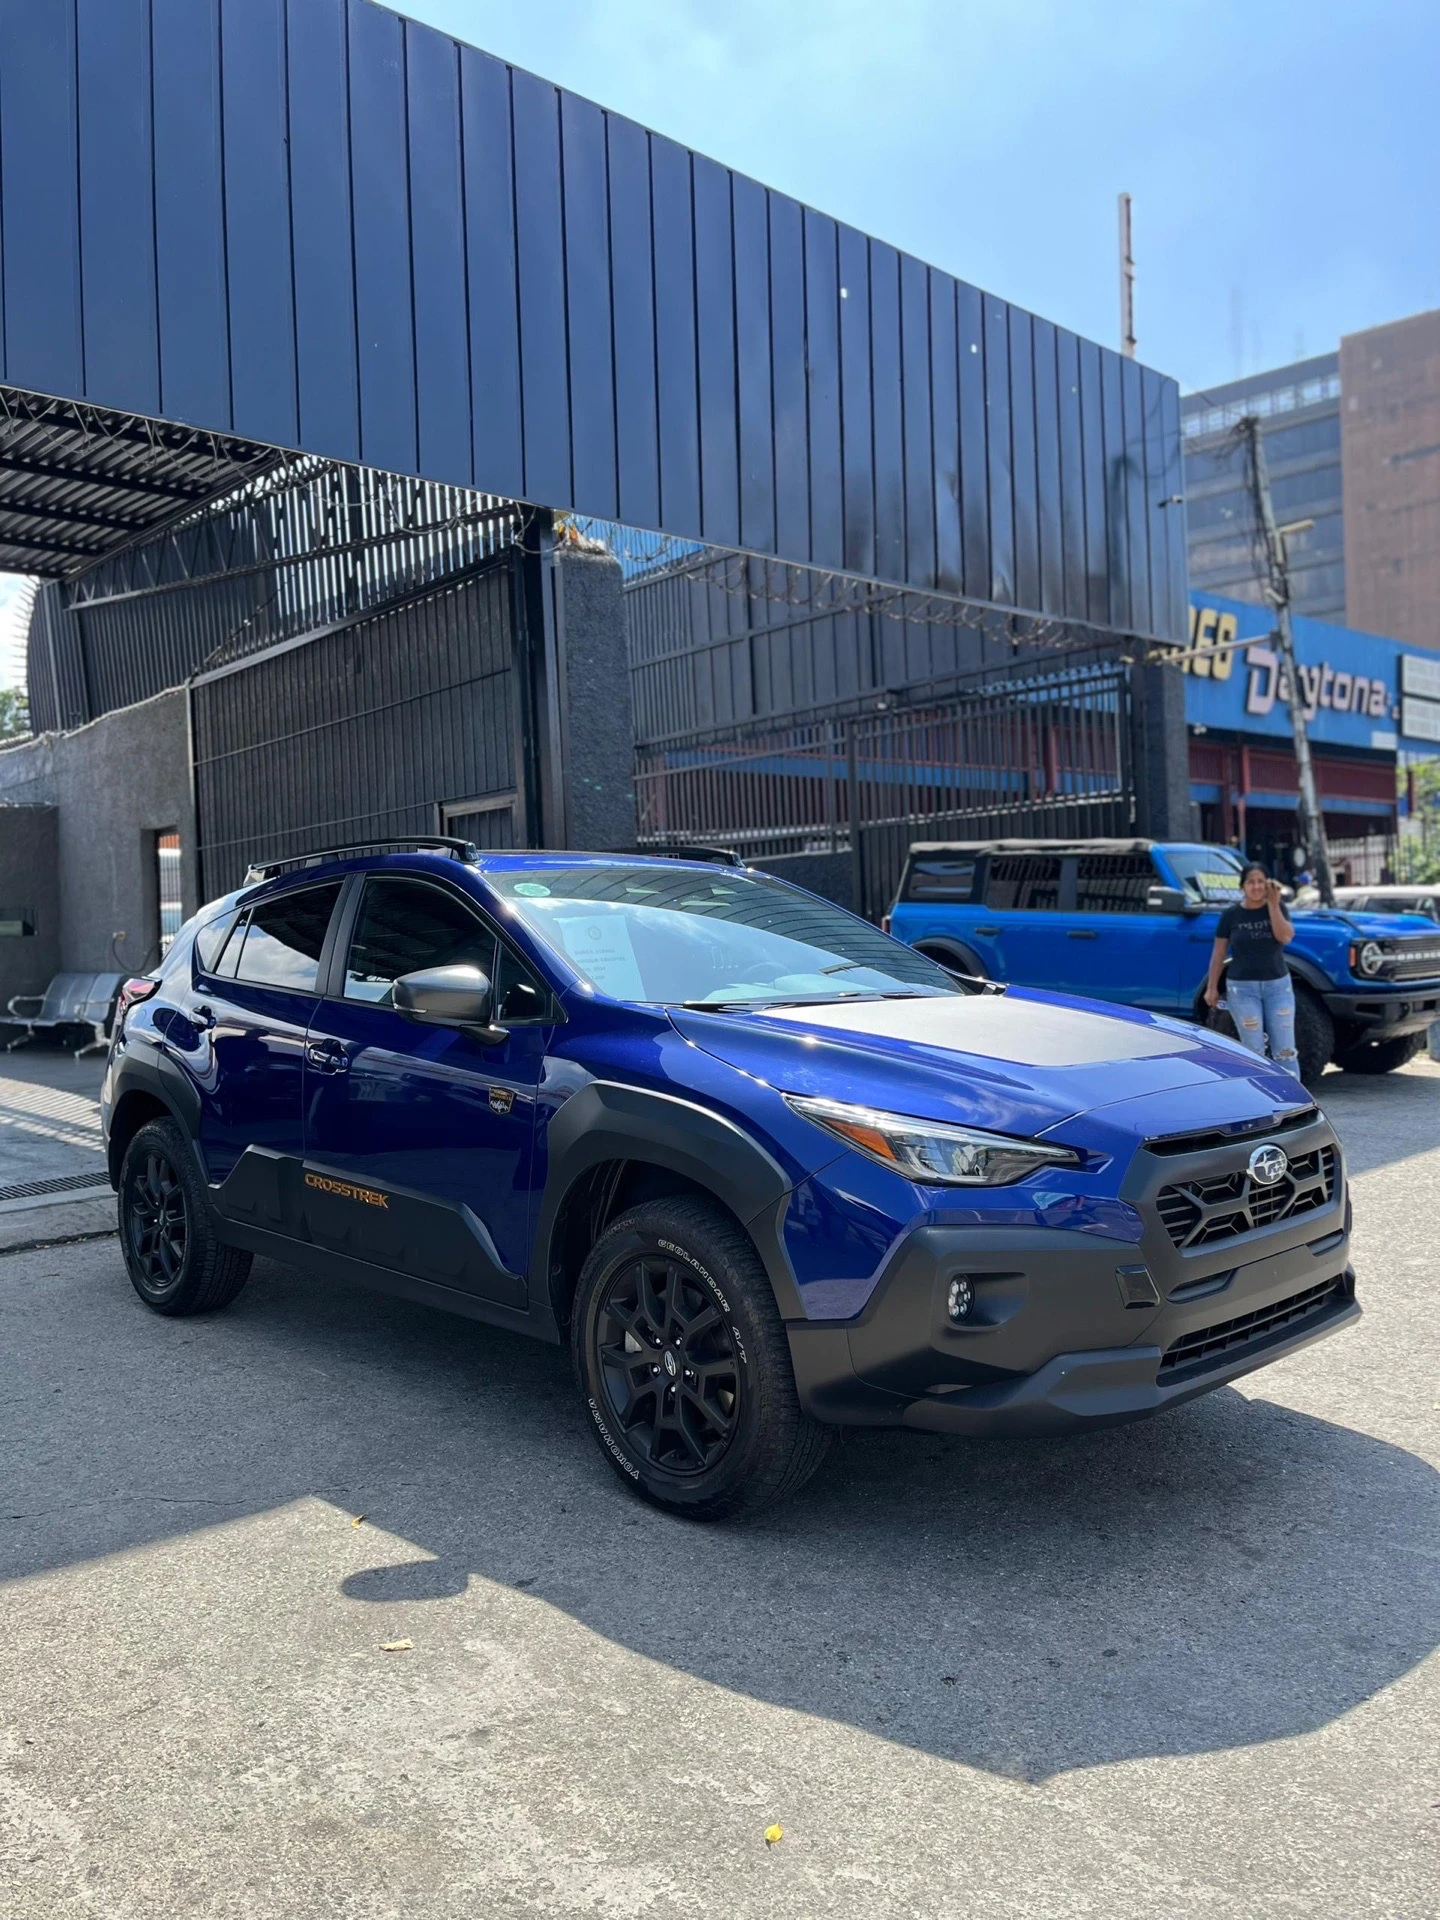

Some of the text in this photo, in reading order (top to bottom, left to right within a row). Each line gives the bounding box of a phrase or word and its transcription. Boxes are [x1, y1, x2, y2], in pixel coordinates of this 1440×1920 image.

[1246, 645, 1387, 720] Daytona
[304, 1173, 389, 1209] CROSSTREK
[657, 1239, 730, 1312] GEOLANDAR
[588, 1398, 640, 1480] YOKOHAMA
